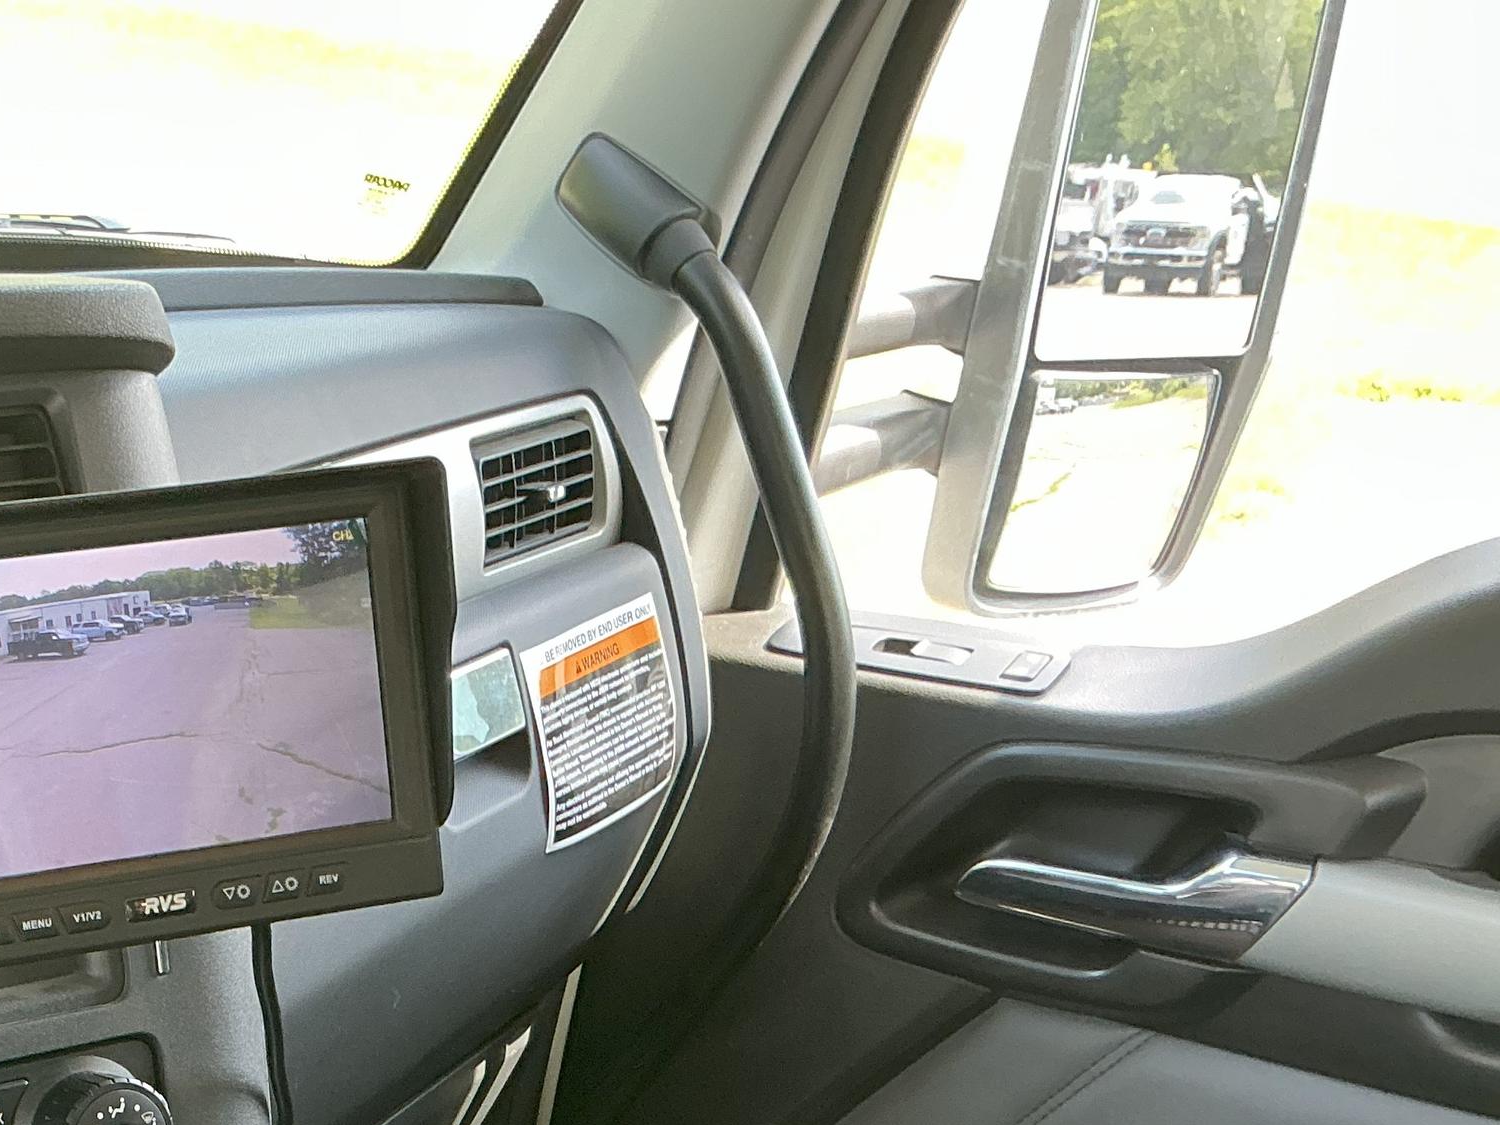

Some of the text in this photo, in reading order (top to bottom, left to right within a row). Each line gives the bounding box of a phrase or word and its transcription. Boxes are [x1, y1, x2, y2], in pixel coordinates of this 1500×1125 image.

[545, 648, 554, 662] BE
[588, 628, 597, 642] BY
[598, 621, 613, 636] END
[614, 611, 633, 628] USER
[581, 642, 620, 670] WARNING
[317, 872, 340, 887] REV
[143, 892, 187, 916] RVS
[22, 915, 53, 932] MENU
[72, 910, 102, 925] V1/V2
